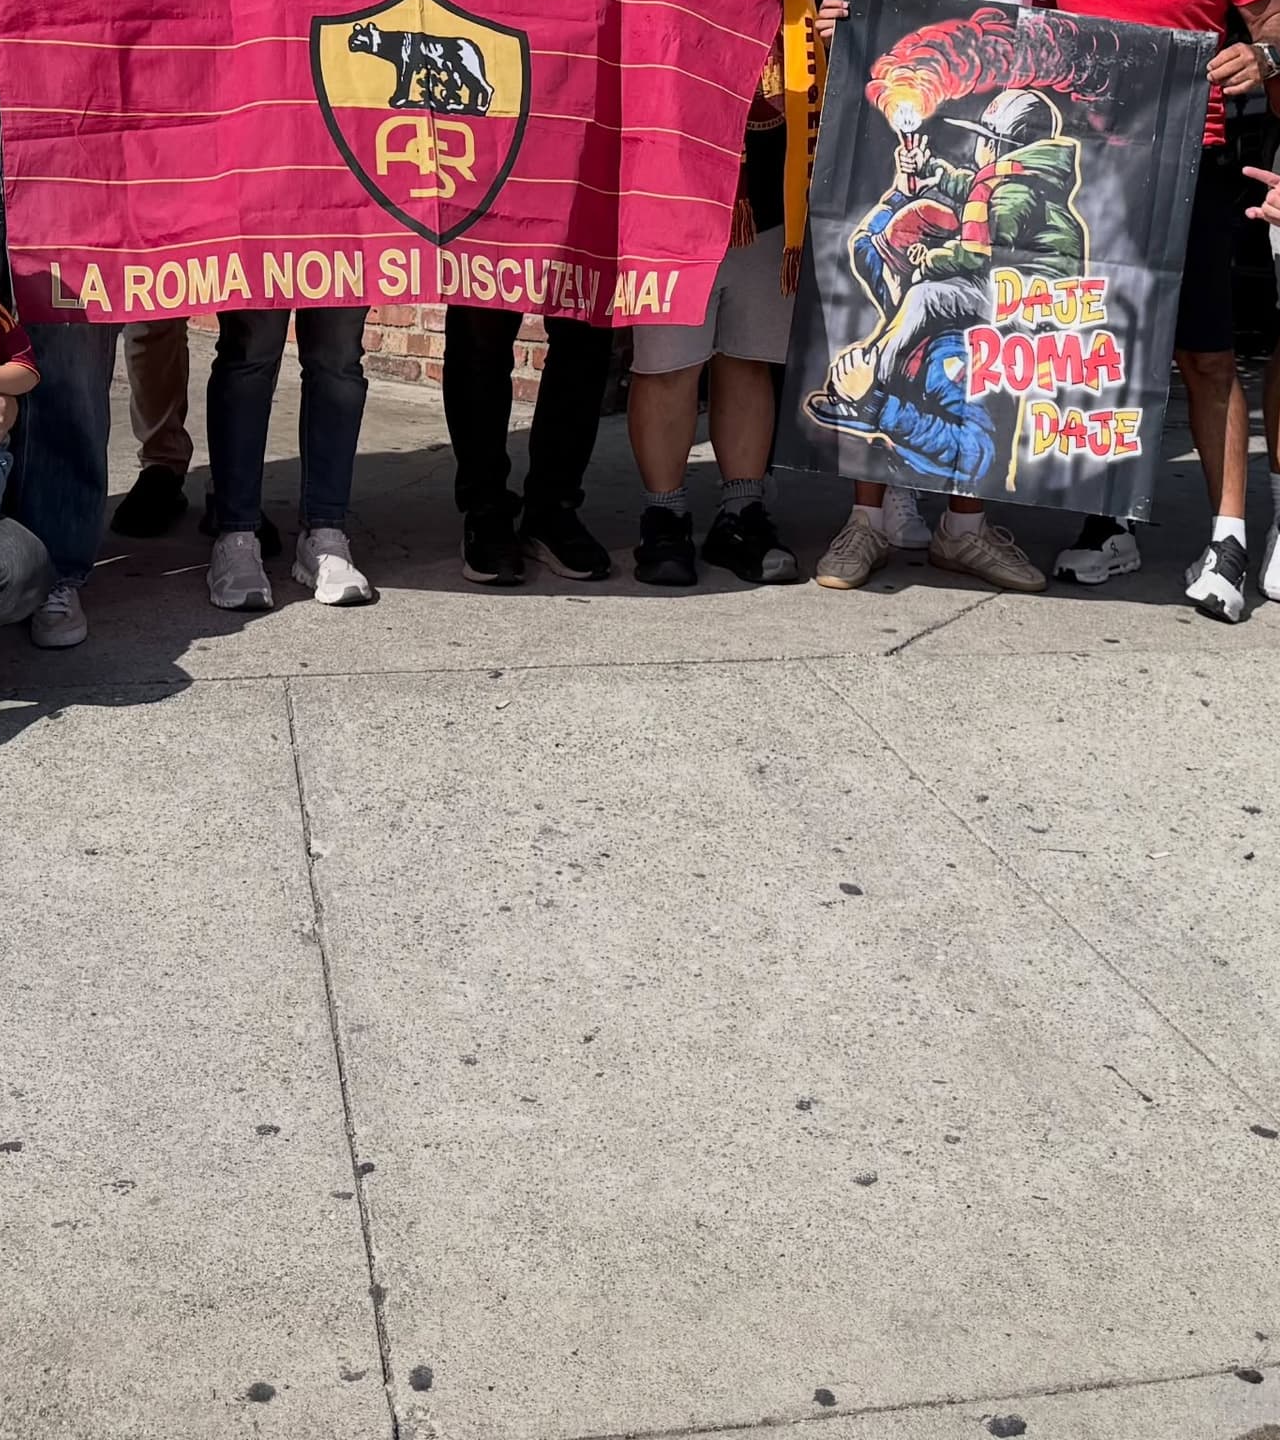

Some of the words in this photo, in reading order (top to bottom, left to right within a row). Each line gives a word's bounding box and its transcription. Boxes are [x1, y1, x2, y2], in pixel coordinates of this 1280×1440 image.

[50, 262, 112, 312] LA
[124, 255, 252, 311] ROMA
[263, 250, 363, 300] NON
[378, 247, 420, 297] SI
[993, 268, 1106, 325] DAJE
[968, 327, 1122, 396] ROMA
[1031, 401, 1139, 457] DAJE
